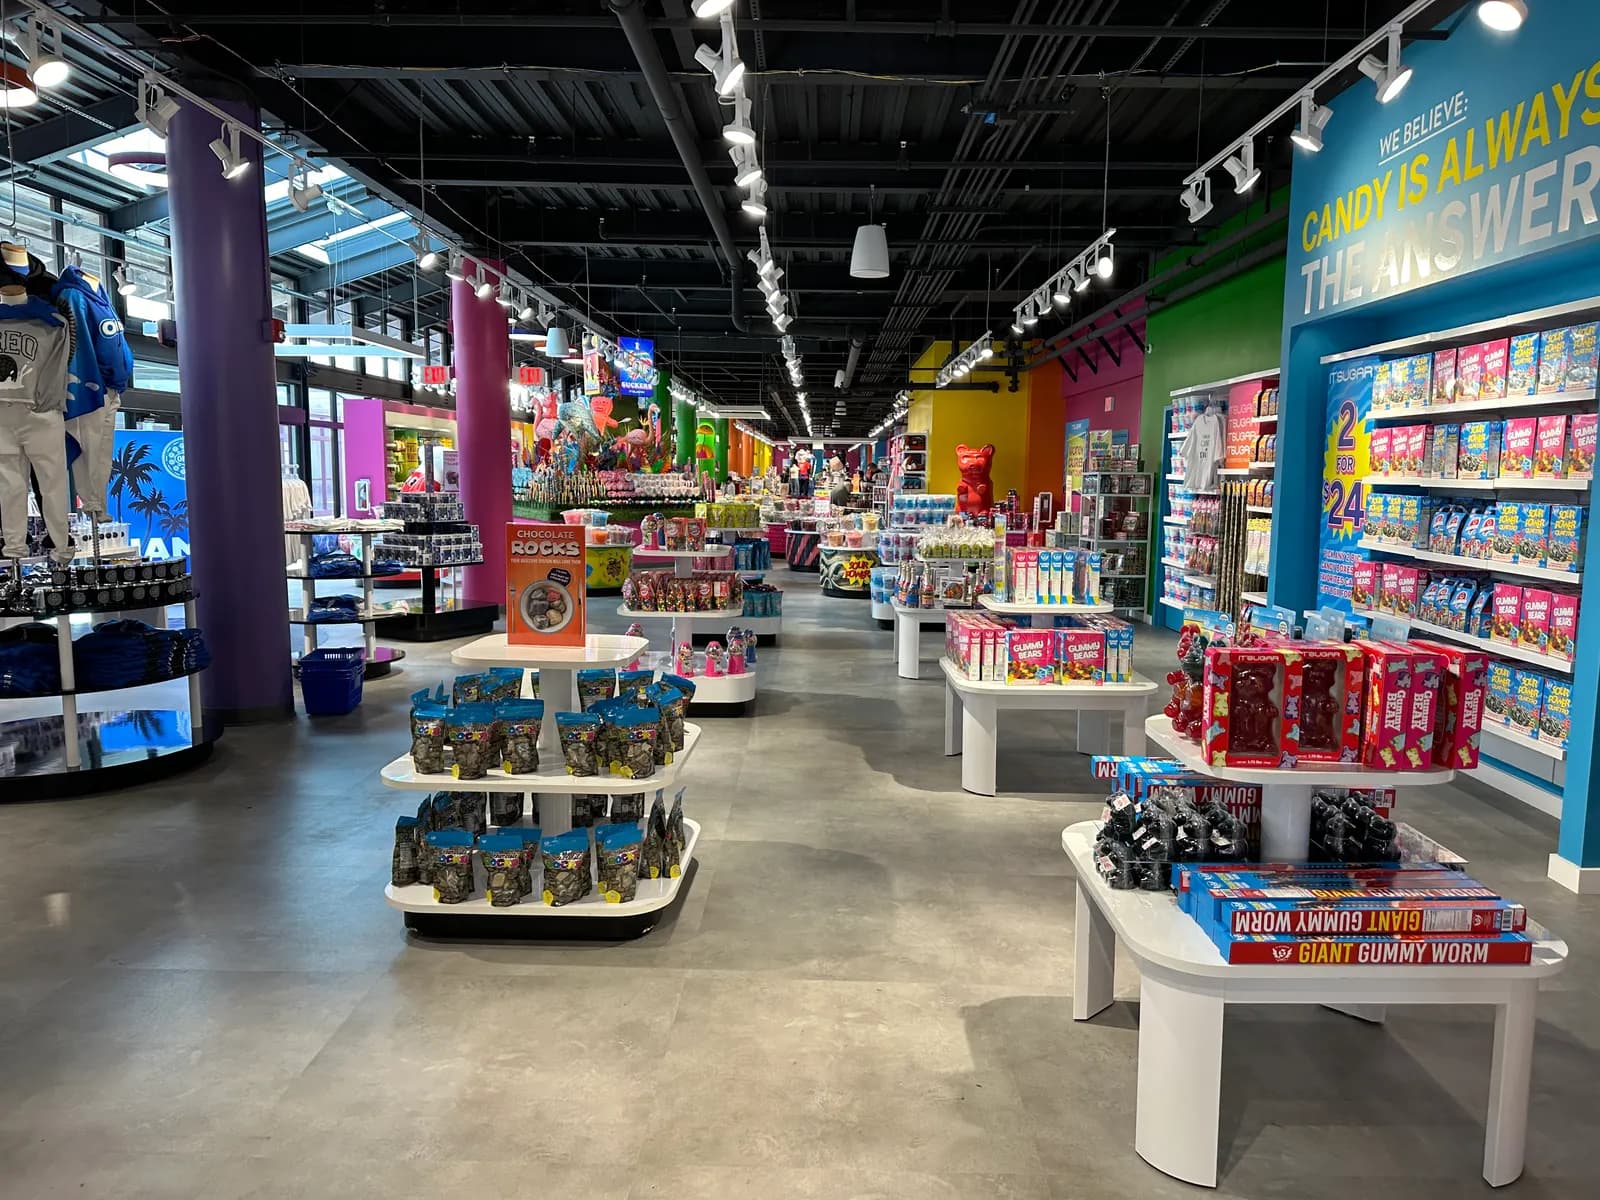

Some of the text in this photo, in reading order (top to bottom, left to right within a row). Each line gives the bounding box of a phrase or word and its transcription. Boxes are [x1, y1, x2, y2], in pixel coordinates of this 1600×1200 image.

[1379, 90, 1469, 158] WE BELIEVE:
[1302, 58, 1600, 252] CANDY IS ALWAYS
[1300, 143, 1600, 316] THE ANSWER
[0, 330, 39, 362] EO
[1484, 348, 1504, 363] GUMMY
[1487, 359, 1503, 370] BEARS
[423, 366, 445, 384] EXIT
[519, 366, 541, 385] EXIT
[1328, 365, 1374, 385] ITSUGAR
[1337, 400, 1357, 450] 2
[1507, 427, 1532, 441] GUMMY
[1539, 426, 1561, 440] GUMMY
[1372, 436, 1389, 446] GUMMY
[1510, 438, 1529, 449] BEARS
[1542, 437, 1560, 448] BEARS
[1336, 455, 1355, 474] FOR
[1321, 478, 1367, 531] $24
[1502, 505, 1518, 515] SOUR
[1528, 508, 1545, 518] SOUR
[1559, 510, 1575, 519] SOUR
[517, 530, 574, 539] CHOCOLATE
[511, 541, 581, 557] ROCKS
[848, 561, 868, 570] SOUR
[846, 570, 871, 580] POWER
[1354, 570, 1372, 578] GUMMY
[1383, 573, 1397, 582] GUMM
[1356, 577, 1371, 585] BEARS
[1399, 578, 1415, 587] GUMMY
[1496, 596, 1518, 606] GUMMY
[1525, 601, 1548, 611] GUMMY
[1498, 605, 1516, 615] BEARS
[1528, 610, 1546, 620] BEARS
[1554, 607, 1573, 617] GUMMY
[1556, 617, 1572, 627] BEARS
[1013, 640, 1044, 653] GUMMY
[1068, 641, 1100, 653] GUMMY
[1018, 650, 1042, 660] BEARS
[1073, 651, 1098, 660] BEARS
[1301, 651, 1341, 659] TSUGAR
[1522, 677, 1538, 687] SOUR
[1552, 686, 1570, 696] SOUR
[1385, 692, 1397, 728] BEAR
[1394, 689, 1406, 731] Gummy
[1411, 693, 1424, 729] BEAR
[1421, 690, 1432, 732] Gummy
[1462, 692, 1474, 728] BEAR
[1471, 688, 1481, 729] Gummy
[1202, 787, 1257, 804] GUMMY
[484, 857, 520, 868] ROCKS
[607, 849, 640, 865] ROCKS
[545, 859, 583, 870] ROCKS
[1311, 888, 1366, 898] GIANT
[1367, 888, 1436, 897] GUMMY
[1433, 887, 1497, 897] WORM
[1235, 911, 1292, 933] WORM
[1295, 911, 1363, 933] GUMMY
[1366, 910, 1421, 932] GIANT
[1298, 942, 1489, 964] GIANT GUMMY WORM
